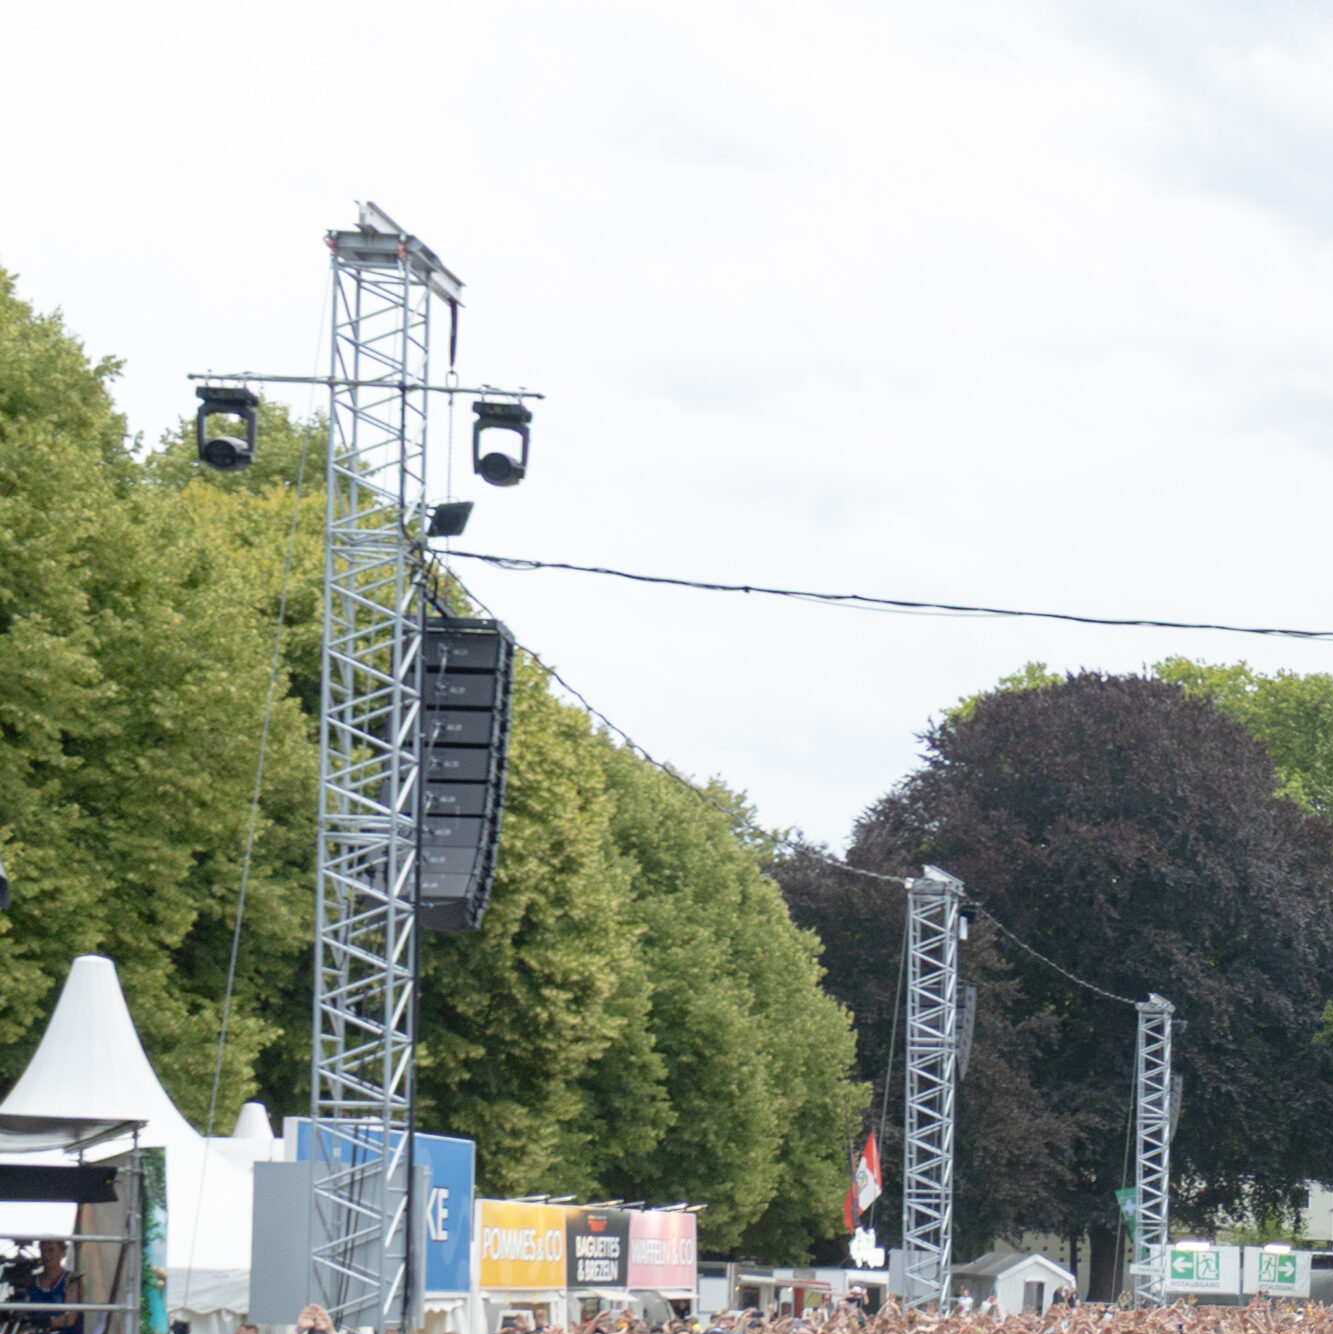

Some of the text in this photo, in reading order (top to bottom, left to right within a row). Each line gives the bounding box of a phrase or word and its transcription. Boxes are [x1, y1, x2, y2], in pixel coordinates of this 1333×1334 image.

[426, 1187, 449, 1241] KE
[482, 1226, 537, 1262] POMMES
[545, 1229, 562, 1263] CO
[576, 1235, 620, 1259] BAGUETTES
